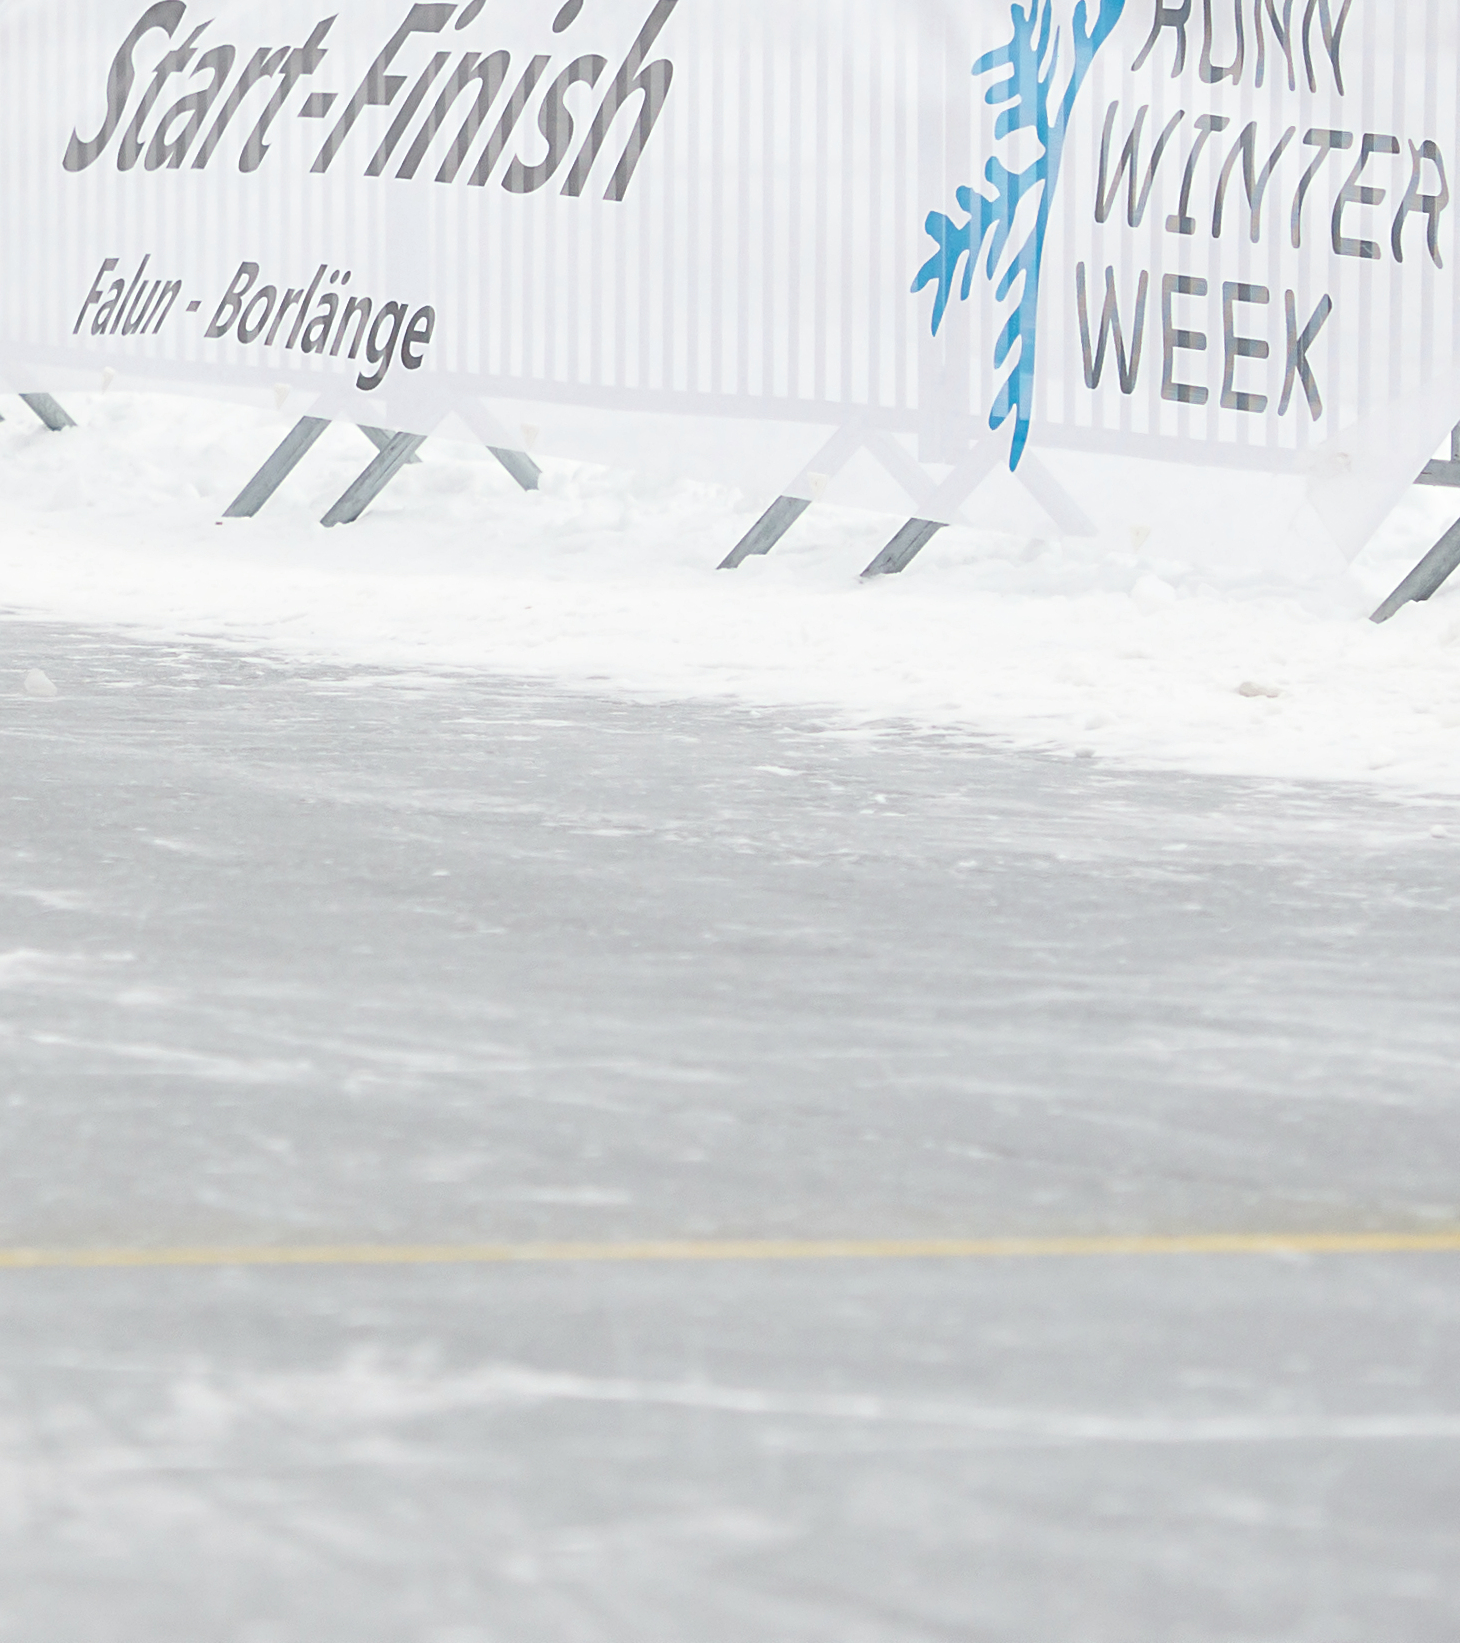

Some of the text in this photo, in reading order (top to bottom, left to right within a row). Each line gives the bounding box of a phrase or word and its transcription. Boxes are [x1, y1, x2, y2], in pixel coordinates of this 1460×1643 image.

[1093, 99, 1451, 268] WINTER
[73, 253, 182, 336] Falun
[204, 261, 436, 391] Borlänge
[1077, 260, 1334, 422] WEEK
